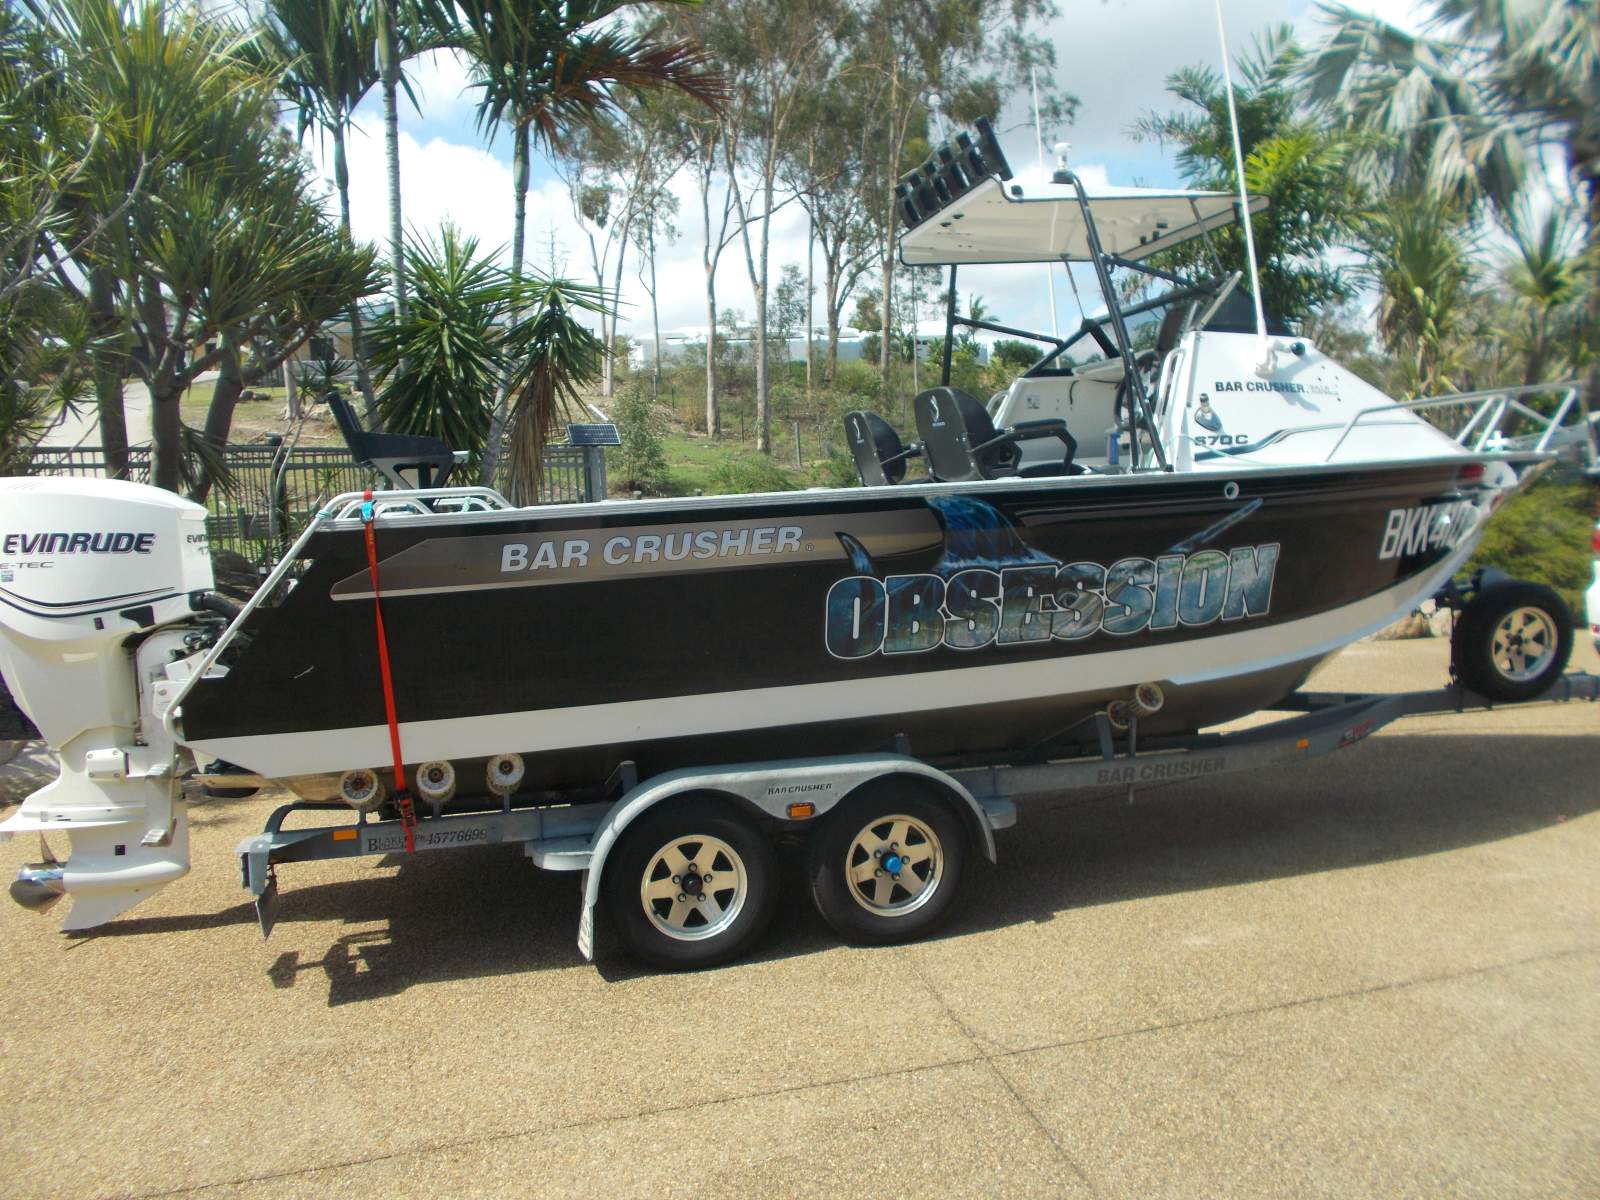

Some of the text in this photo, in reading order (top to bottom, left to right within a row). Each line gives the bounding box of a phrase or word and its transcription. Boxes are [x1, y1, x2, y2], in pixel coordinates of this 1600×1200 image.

[1215, 381, 1243, 392] BAR
[1246, 381, 1305, 393] CRUSHER
[3, 532, 156, 554] EVINRUDE
[500, 526, 803, 573] BAR CRUSHER
[825, 542, 1280, 659] OBSESSION
[1096, 758, 1227, 784] BAR CRUSHER
[767, 783, 832, 796] BAR CRUSHER
